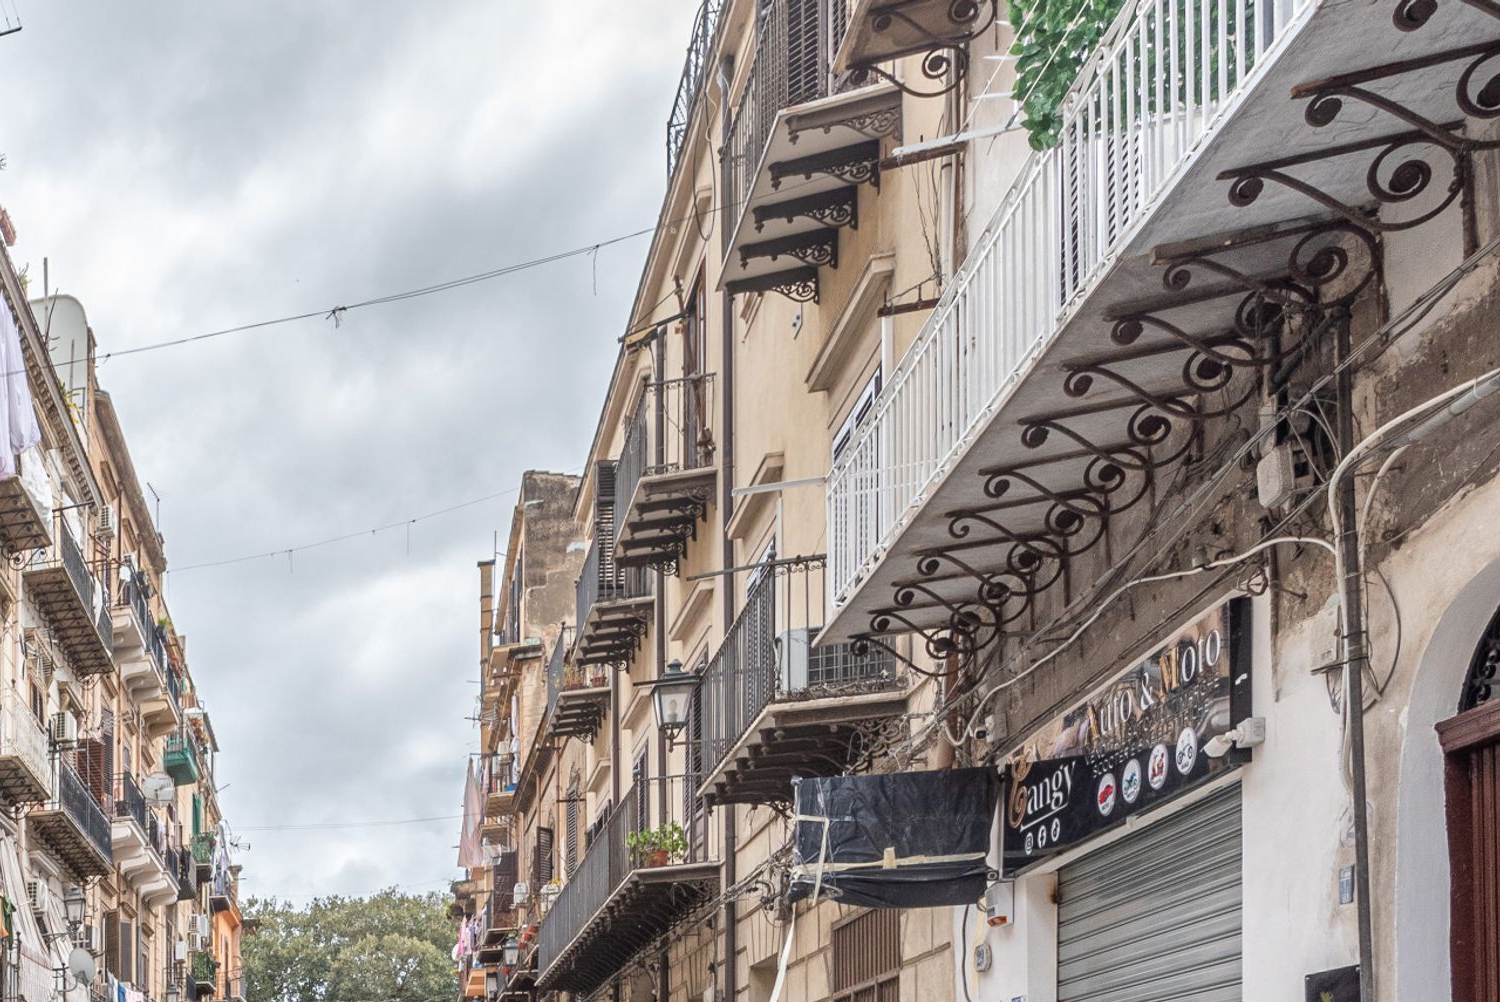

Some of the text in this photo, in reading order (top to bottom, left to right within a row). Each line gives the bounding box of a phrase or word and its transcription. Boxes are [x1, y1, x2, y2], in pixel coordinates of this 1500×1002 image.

[1083, 629, 1221, 754] Auto & Moto
[1093, 744, 1131, 778] SCOOTER
